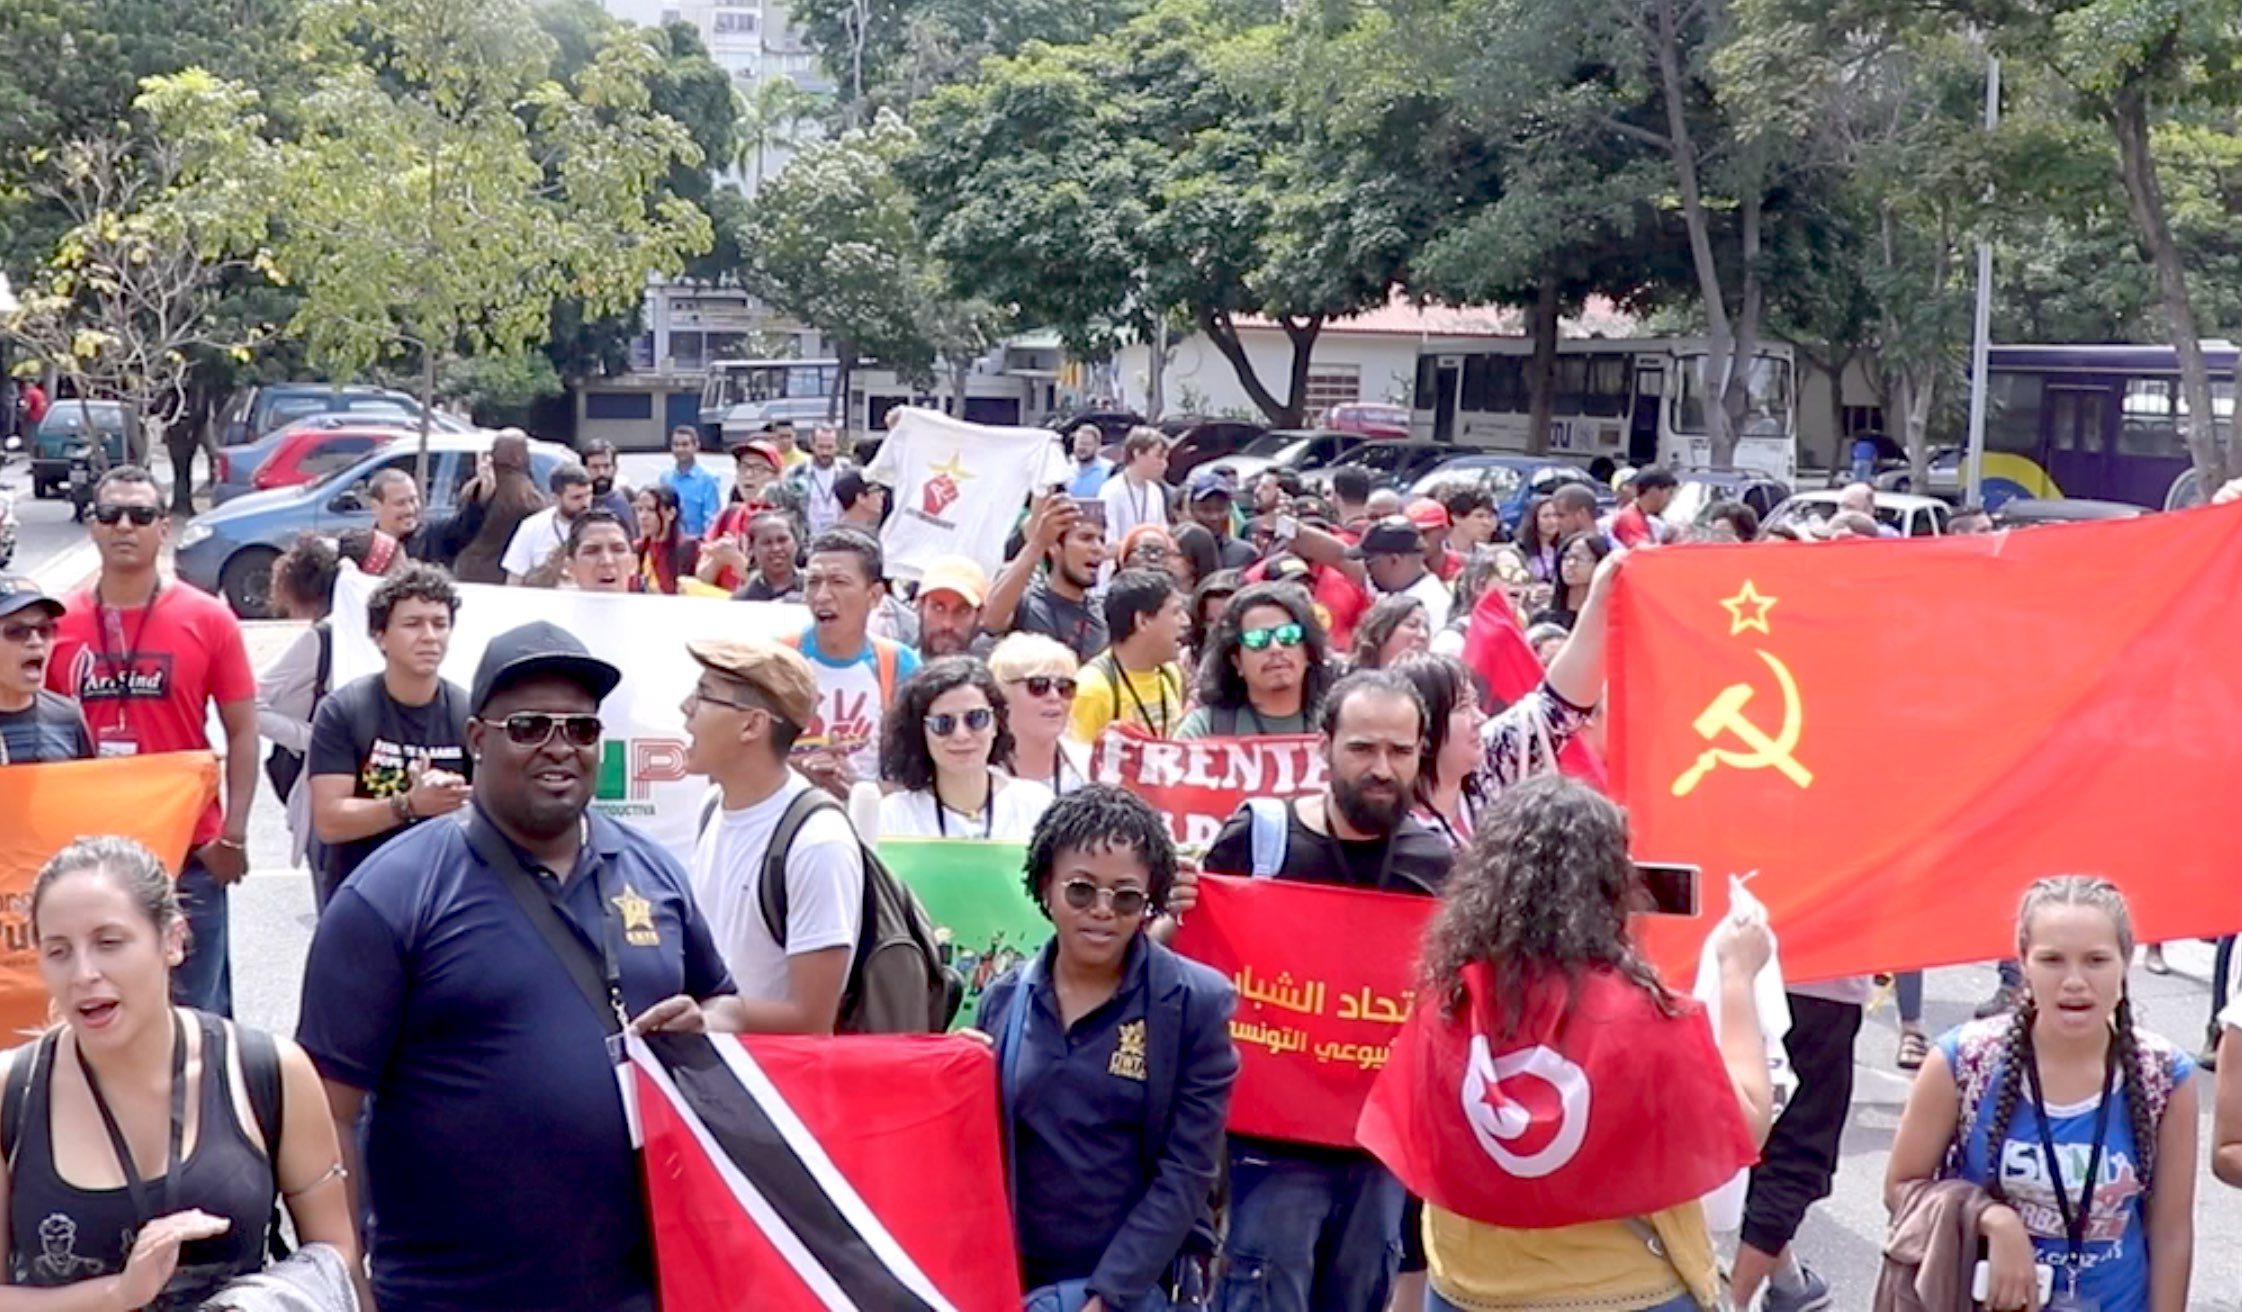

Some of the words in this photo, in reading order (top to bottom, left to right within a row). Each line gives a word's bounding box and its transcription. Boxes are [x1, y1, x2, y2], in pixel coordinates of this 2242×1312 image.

[1097, 728, 1331, 793] FRENTE
[1337, 986, 1416, 1024] تحاد
[1229, 1019, 1307, 1054] التونس
